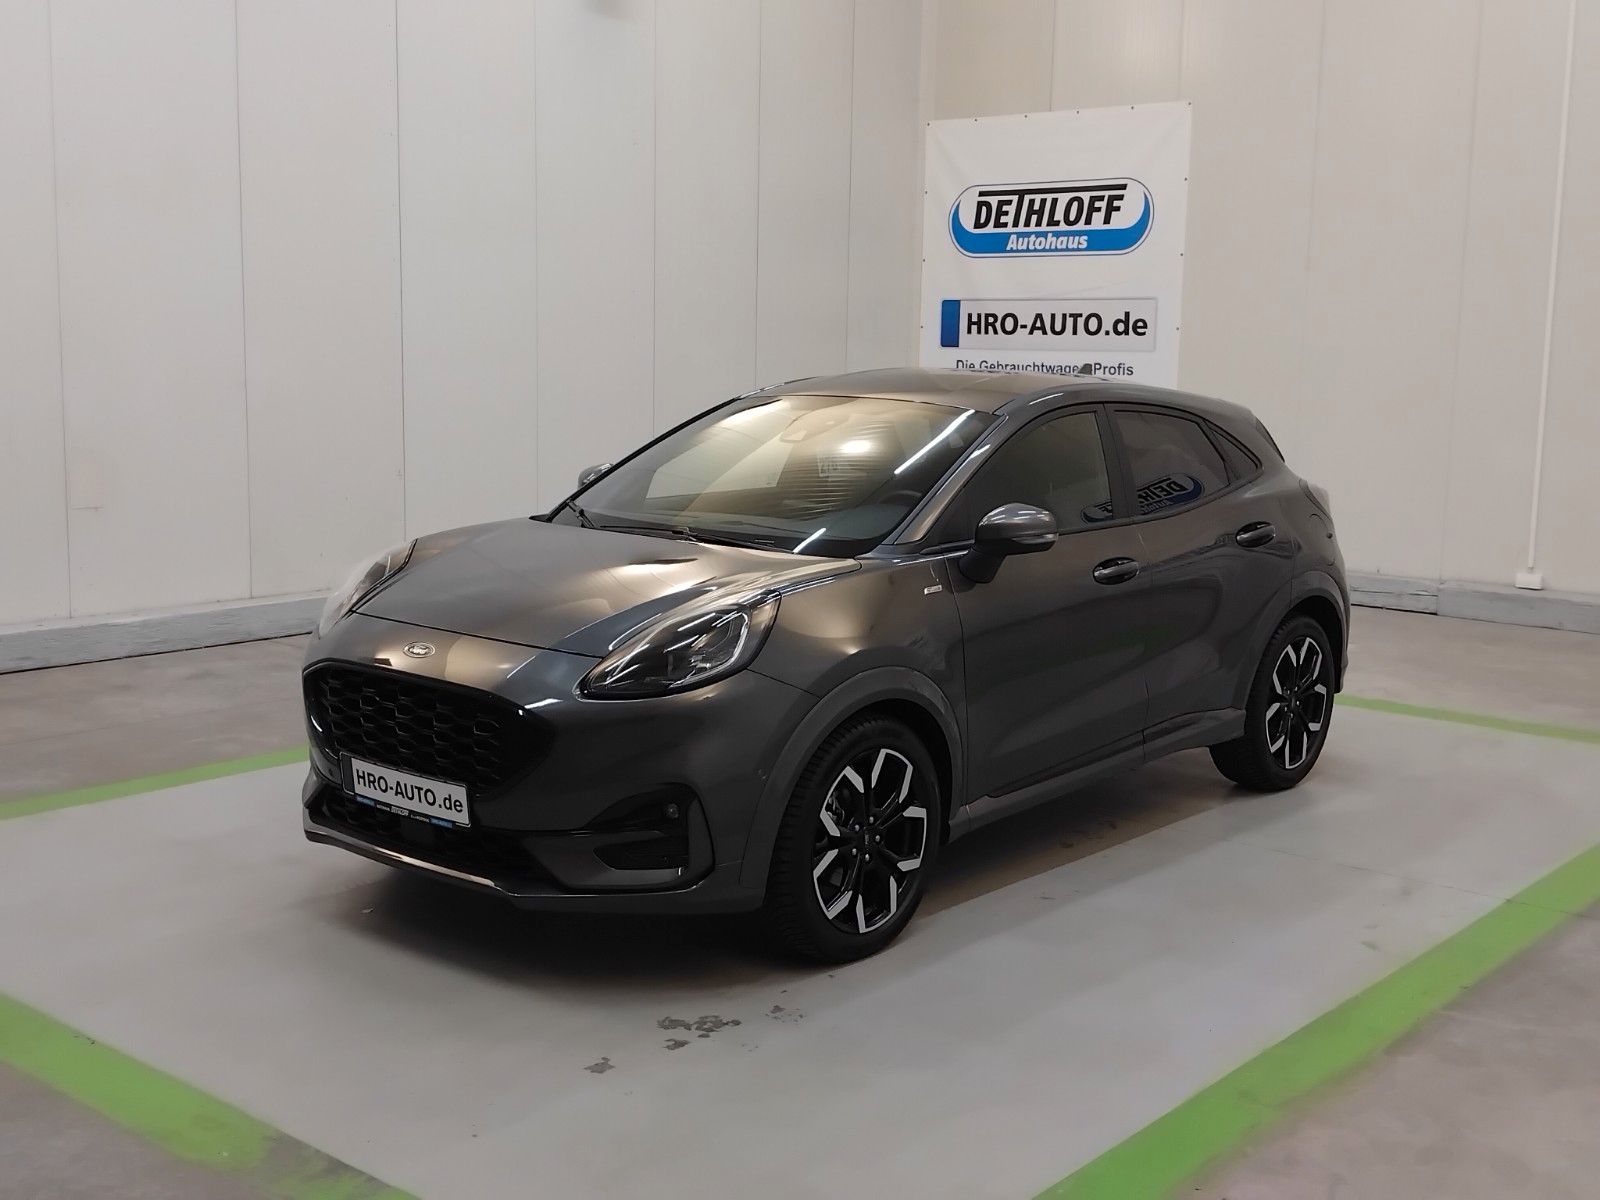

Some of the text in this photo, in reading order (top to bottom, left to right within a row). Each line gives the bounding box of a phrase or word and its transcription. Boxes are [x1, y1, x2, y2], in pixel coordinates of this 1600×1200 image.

[973, 183, 1128, 230] DETHLOFF
[1006, 232, 1088, 252] Autohaus
[966, 310, 1149, 337] HRO-AUTO.de
[1093, 362, 1135, 376] Profis
[356, 768, 464, 814] HRO-AUTO.de
